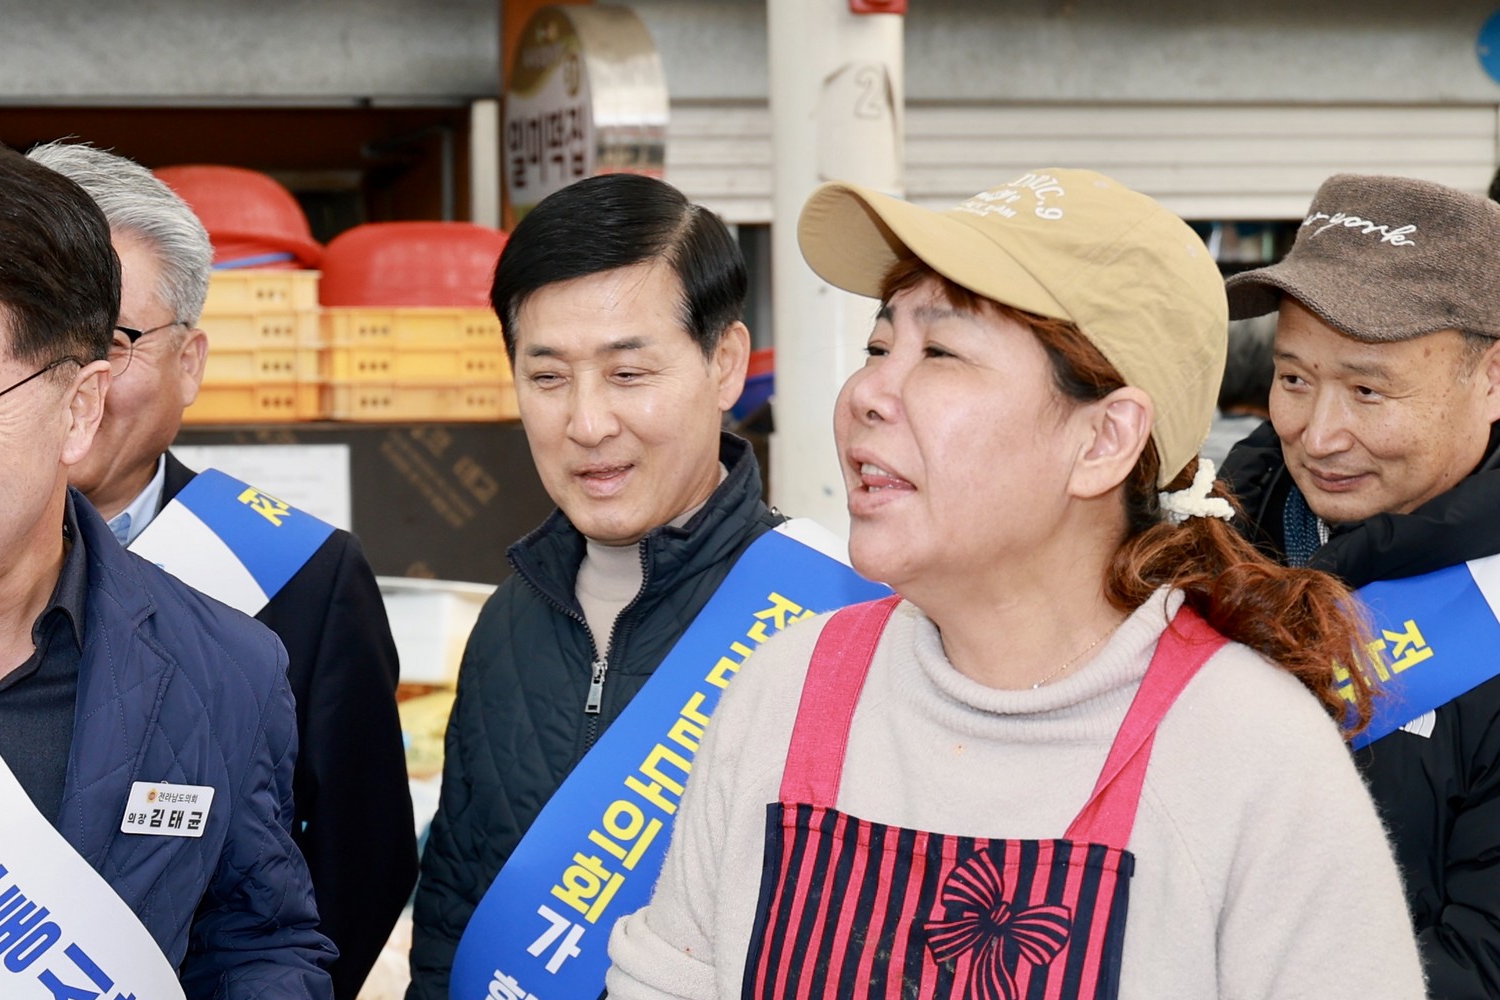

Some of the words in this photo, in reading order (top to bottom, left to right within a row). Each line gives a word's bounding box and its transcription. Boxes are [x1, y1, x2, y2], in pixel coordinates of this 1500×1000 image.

[853, 65, 882, 121] 2
[158, 791, 198, 804] 전라남도의회
[127, 812, 147, 825] 의장
